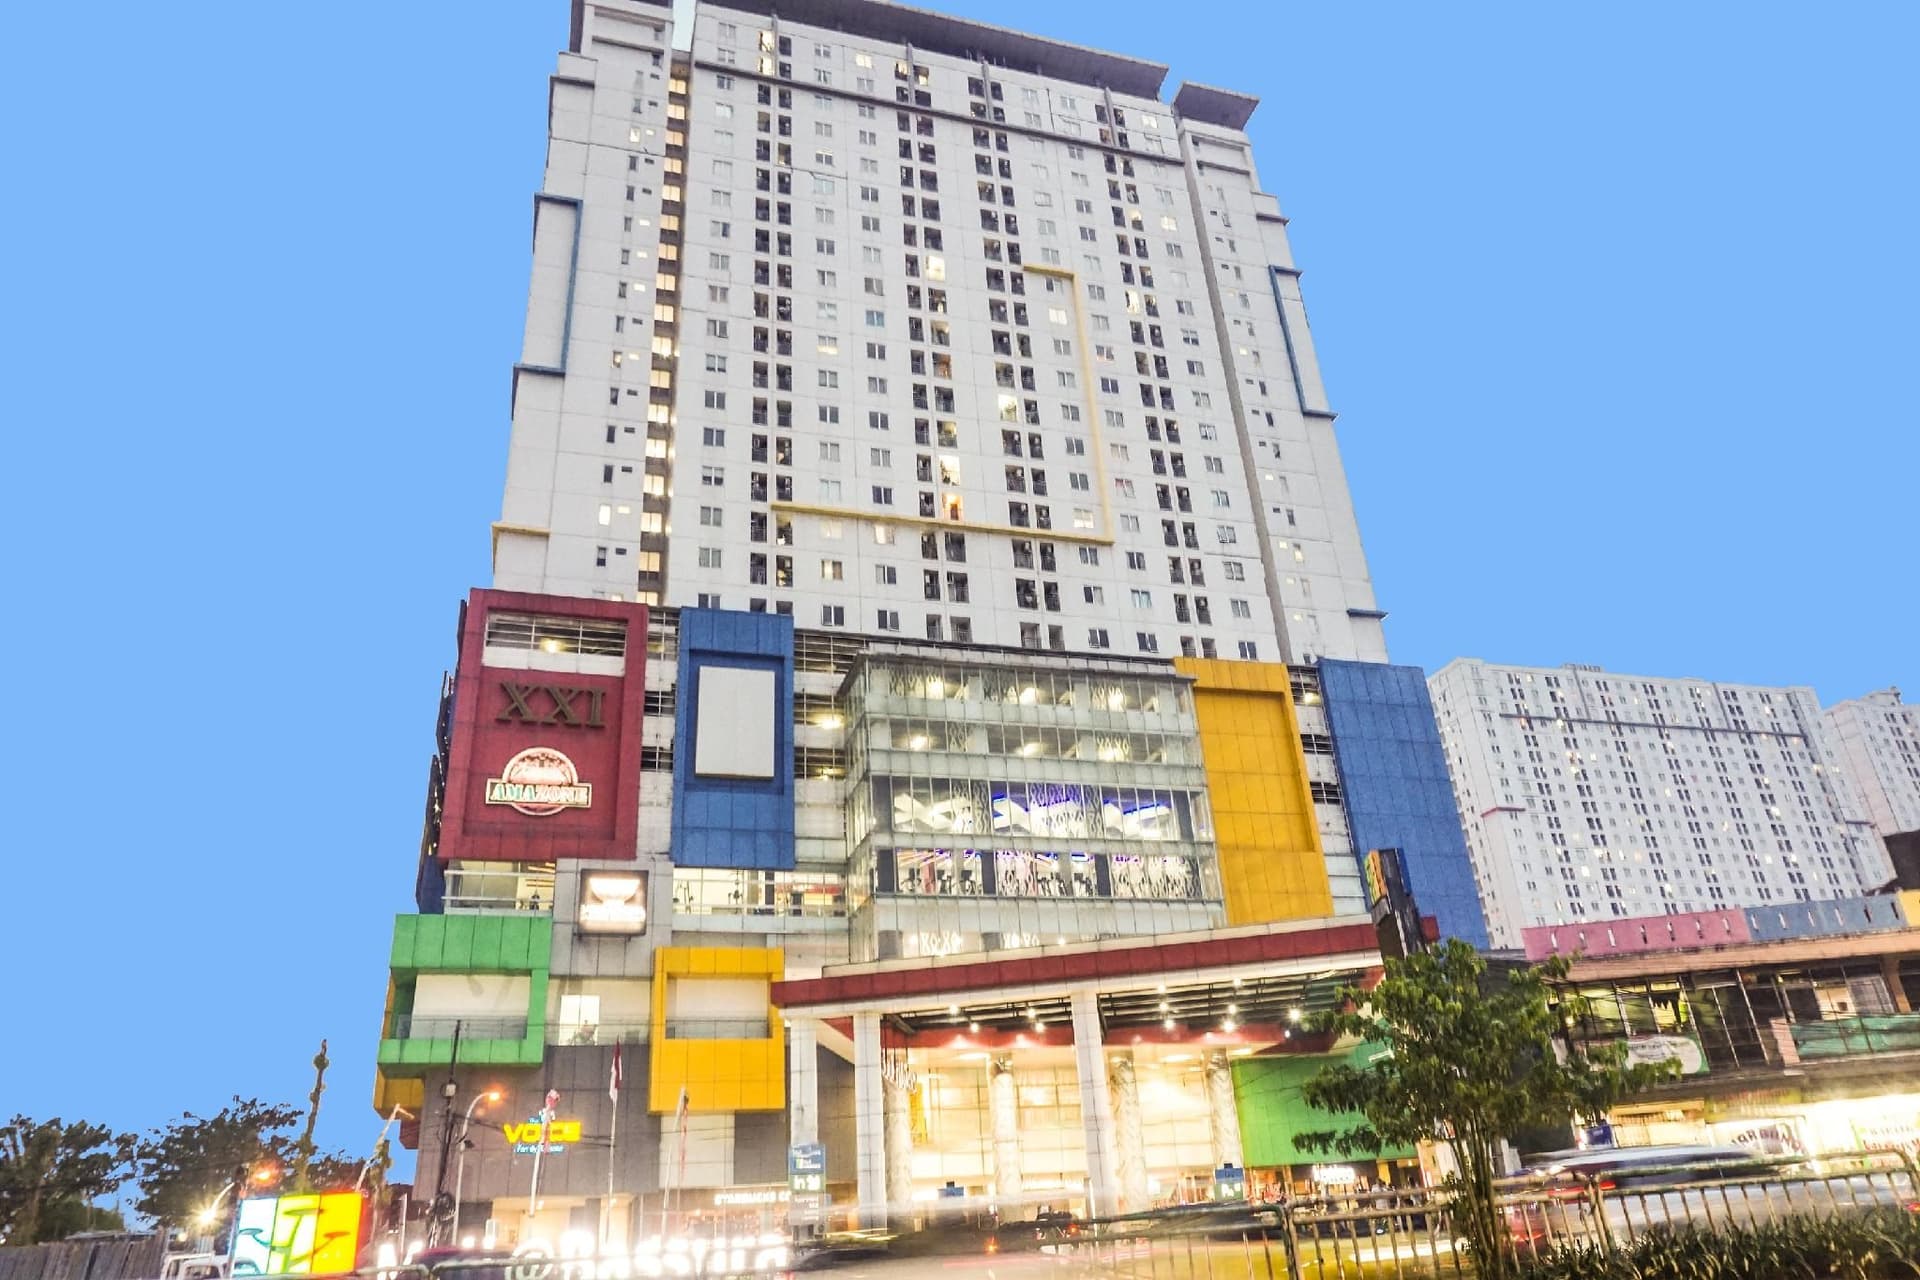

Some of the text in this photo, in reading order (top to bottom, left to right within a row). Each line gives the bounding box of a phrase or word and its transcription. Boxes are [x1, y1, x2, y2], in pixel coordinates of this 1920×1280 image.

[496, 681, 606, 728] XXI
[490, 783, 588, 806] AMAZONE
[503, 1120, 582, 1144] VOCE
